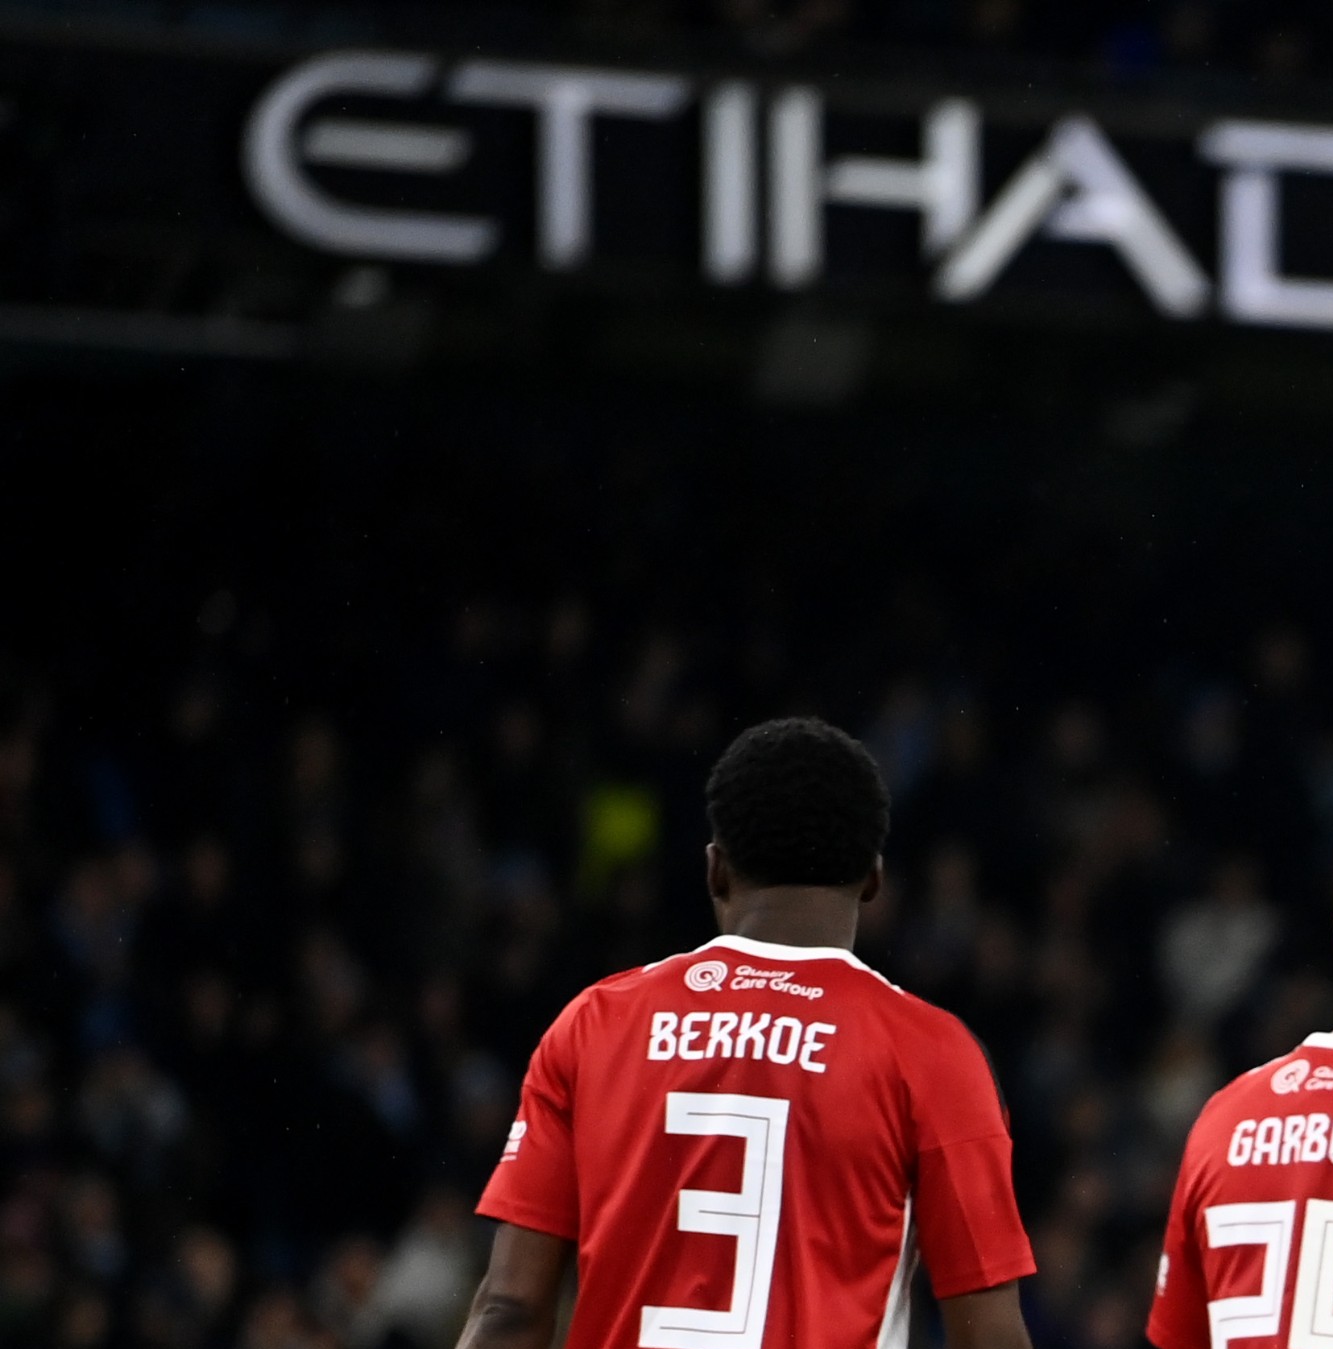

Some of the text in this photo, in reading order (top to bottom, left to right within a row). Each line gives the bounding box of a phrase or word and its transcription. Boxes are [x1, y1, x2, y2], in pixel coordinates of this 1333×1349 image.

[730, 976, 825, 1000] Care Group
[646, 1011, 837, 1074] BERKOE
